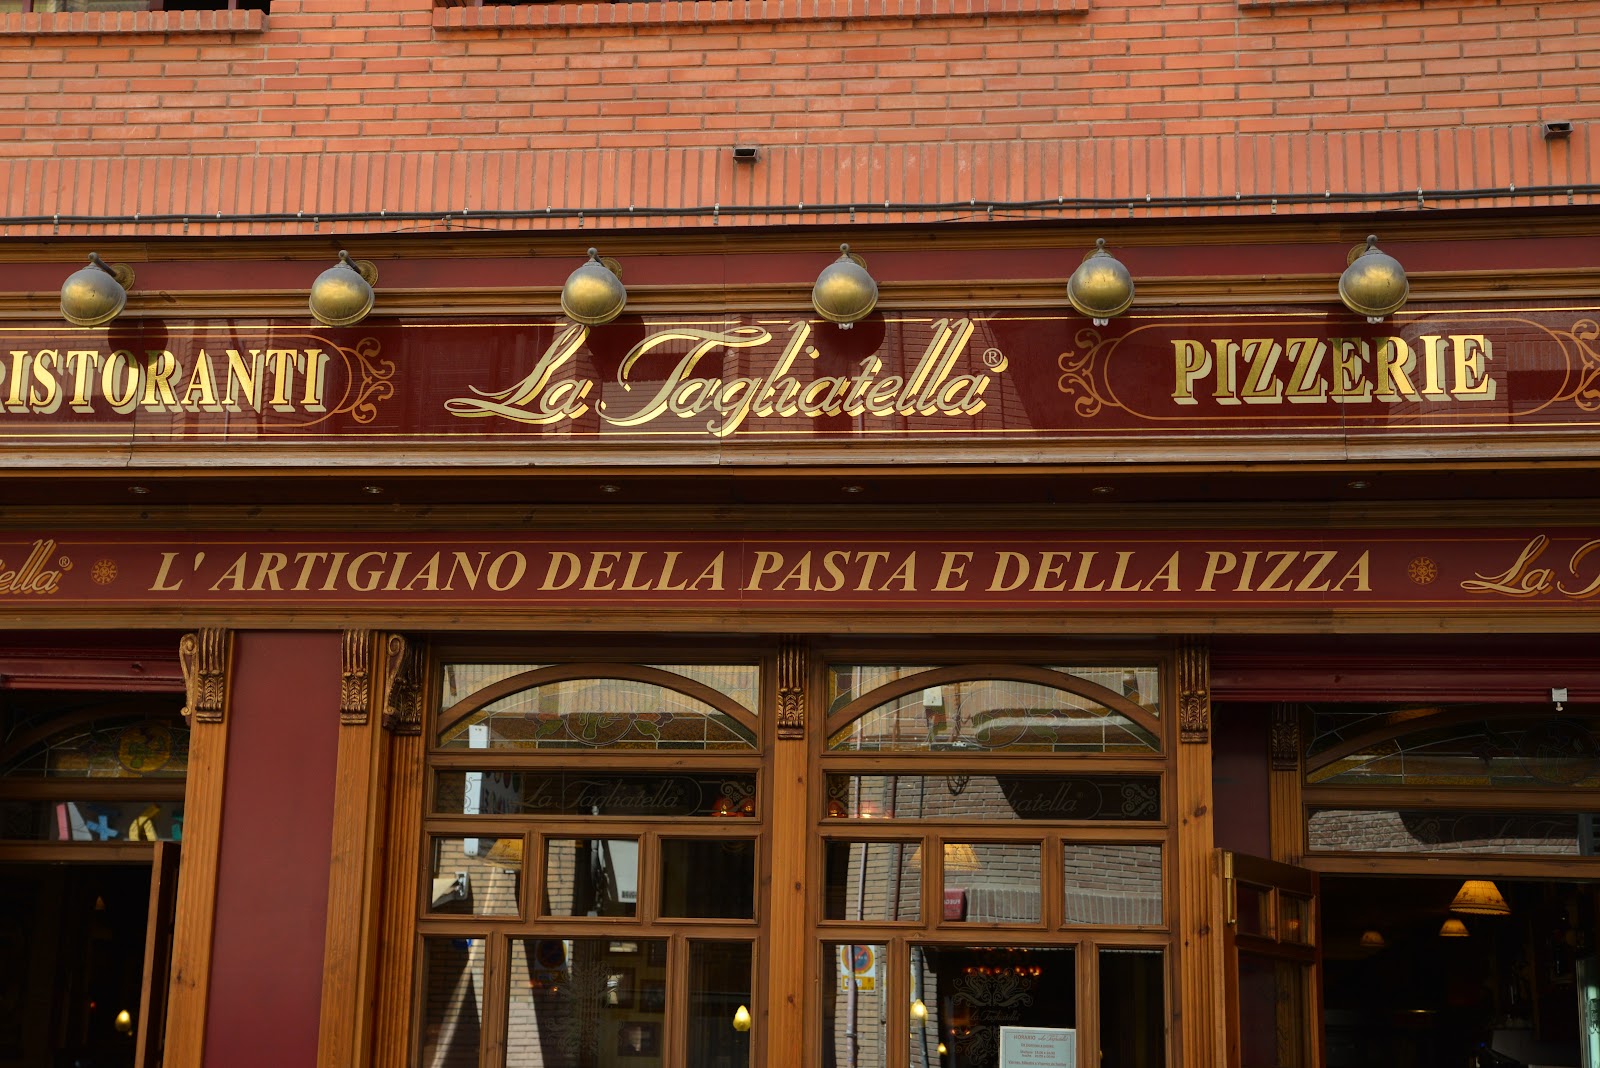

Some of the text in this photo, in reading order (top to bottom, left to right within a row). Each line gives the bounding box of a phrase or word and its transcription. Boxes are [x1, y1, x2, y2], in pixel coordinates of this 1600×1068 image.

[0, 348, 328, 414] ISTORANTI
[443, 324, 595, 426] La
[1170, 333, 1497, 405] PIZZERIE
[538, 550, 726, 593] DELLA
[740, 550, 922, 593] PASTA
[931, 550, 972, 593] E
[985, 550, 1183, 593] DELLA
[1196, 550, 1374, 593] PIZZA
[1460, 534, 1554, 598] La
